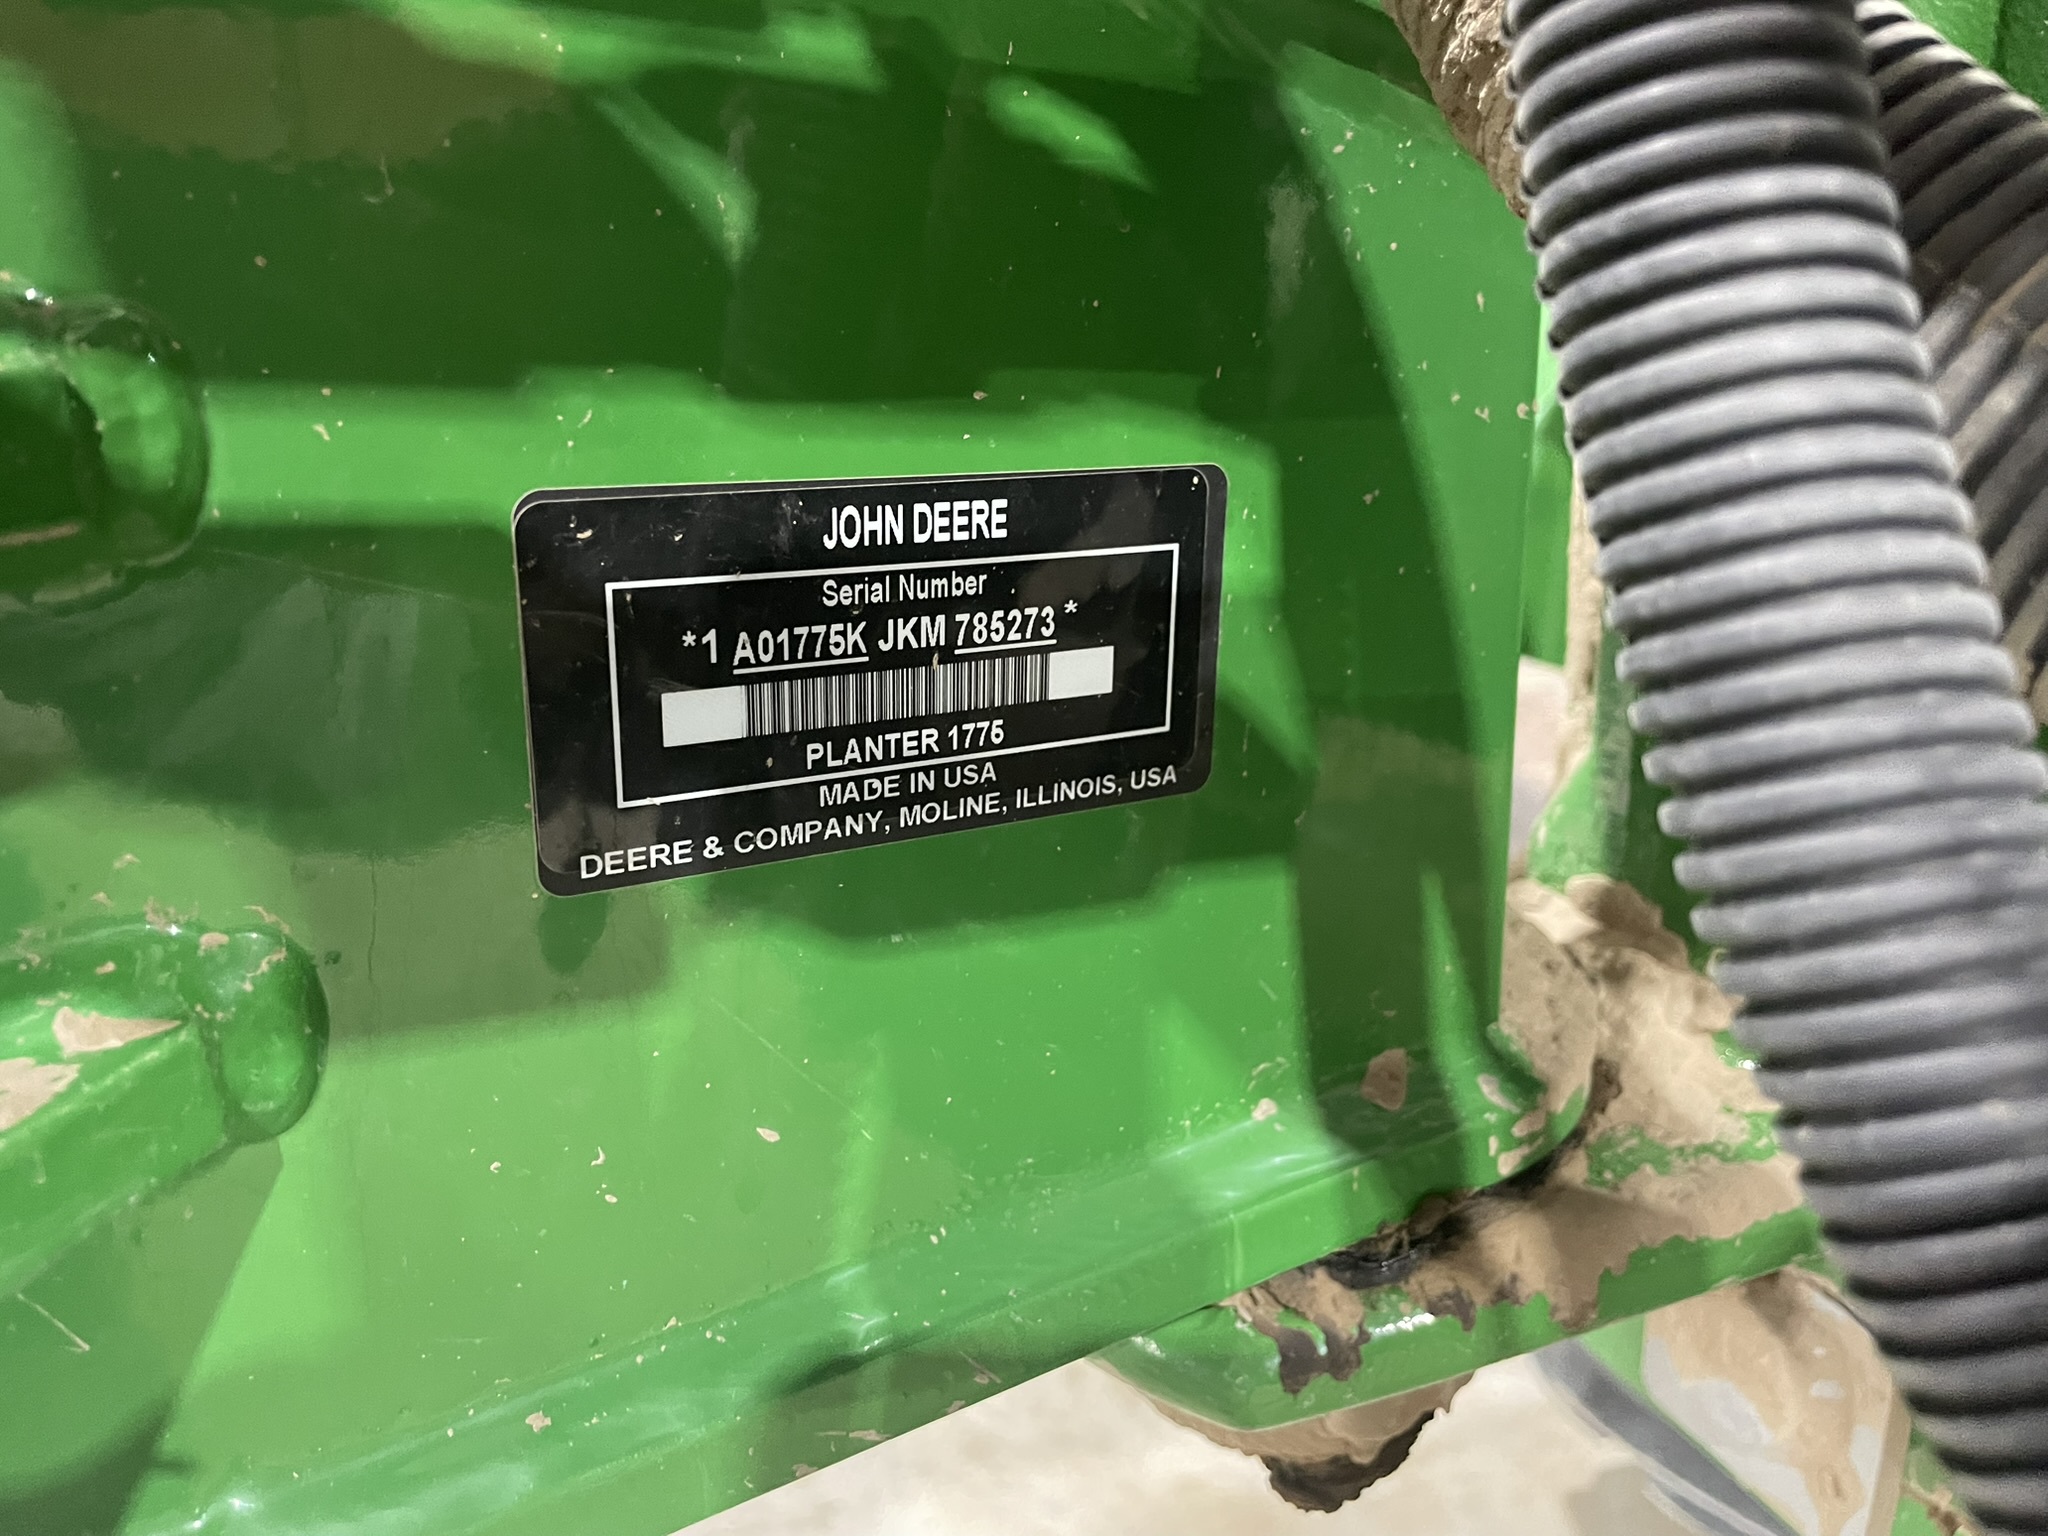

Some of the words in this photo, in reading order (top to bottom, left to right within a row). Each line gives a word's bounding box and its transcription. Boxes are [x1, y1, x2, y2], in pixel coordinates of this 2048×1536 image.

[822, 501, 905, 550] JOHN
[913, 498, 1009, 544] DEERE
[821, 578, 890, 609] Serial
[899, 570, 987, 602] Number
[731, 621, 867, 668] A01775K
[876, 613, 947, 652] JKM
[954, 605, 1058, 649] 785273
[805, 728, 941, 770] PLANTER
[818, 774, 902, 808] MADE
[908, 770, 936, 795] IN
[944, 761, 998, 790] USA
[578, 837, 694, 882] DEERE
[702, 835, 725, 860] &
[732, 809, 891, 855] COMPANY,
[898, 790, 1010, 829] MOLINE,
[1015, 774, 1124, 812] ILLINOIS,
[1130, 764, 1178, 793] USA
